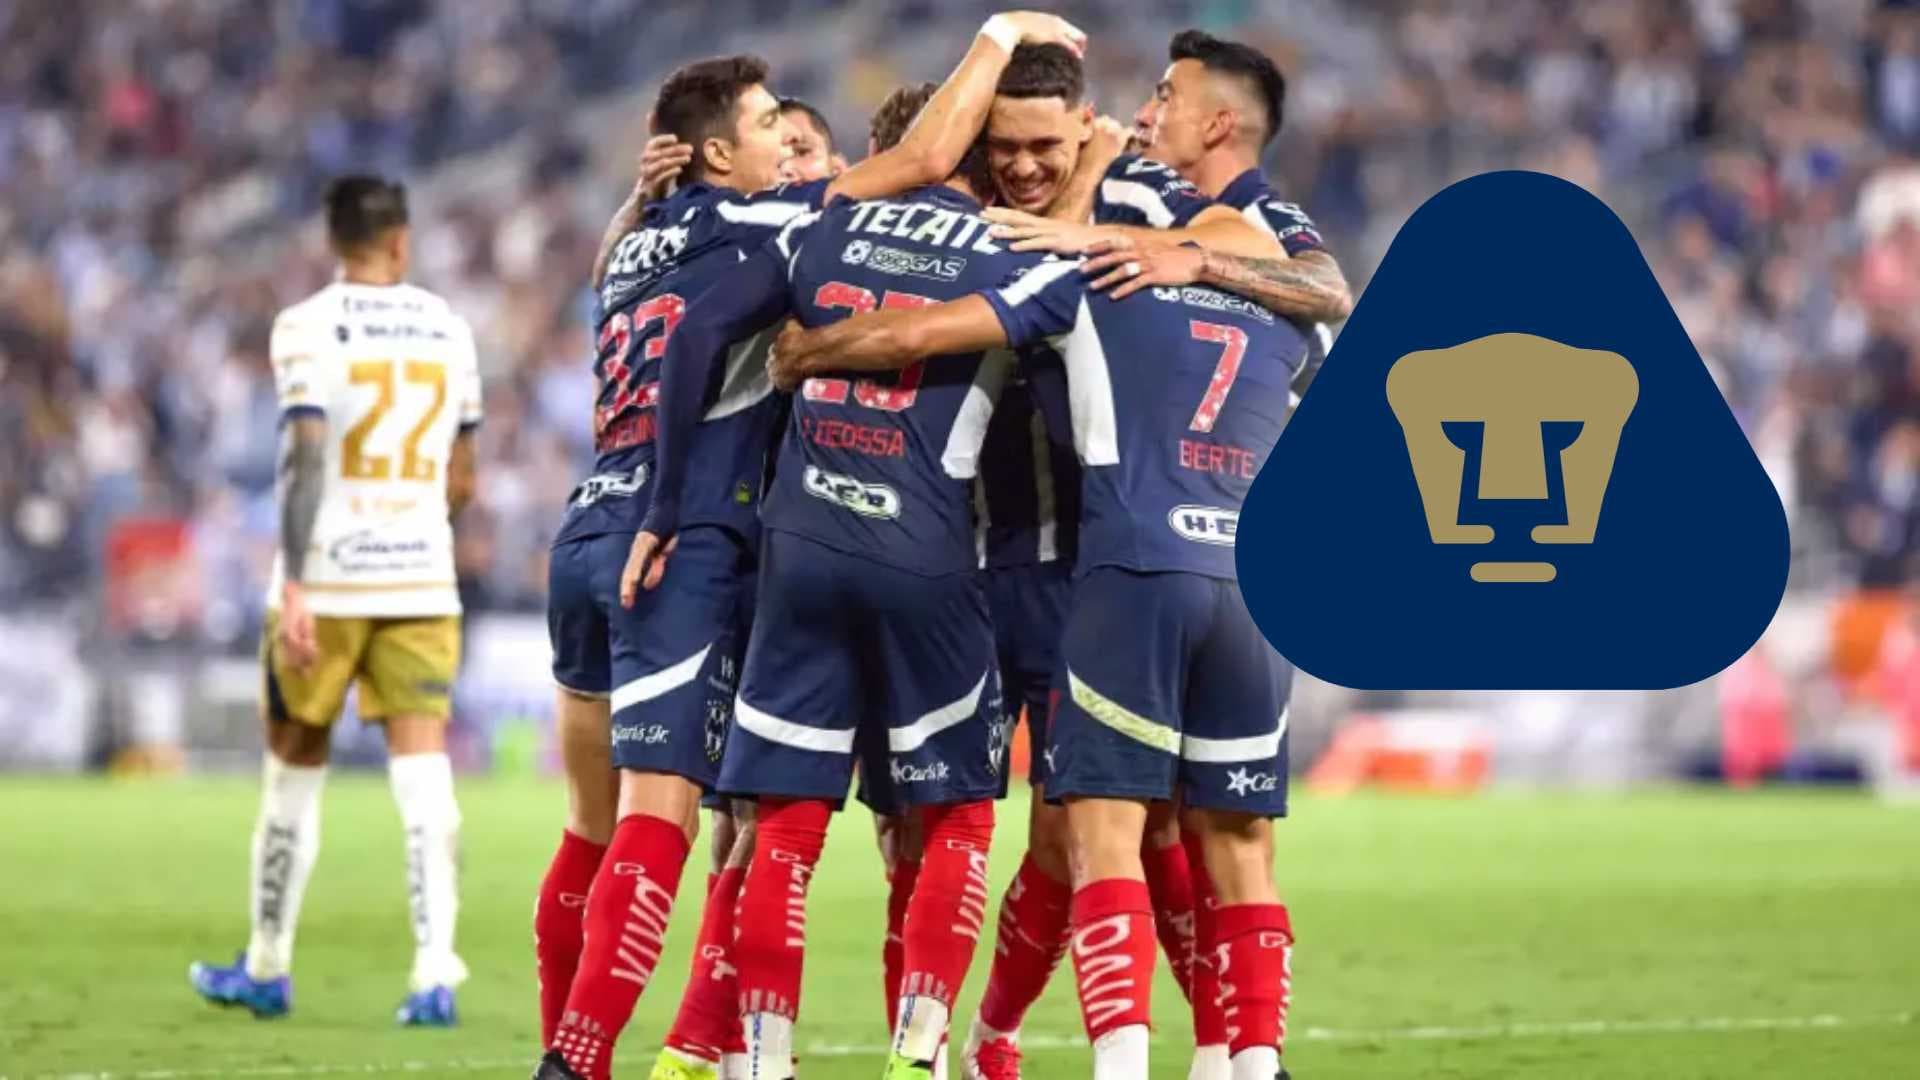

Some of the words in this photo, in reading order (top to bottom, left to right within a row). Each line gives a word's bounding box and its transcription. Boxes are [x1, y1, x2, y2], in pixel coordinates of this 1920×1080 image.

[846, 199, 1003, 255] TECATE
[341, 360, 447, 480] 22
[1189, 320, 1248, 432] 7
